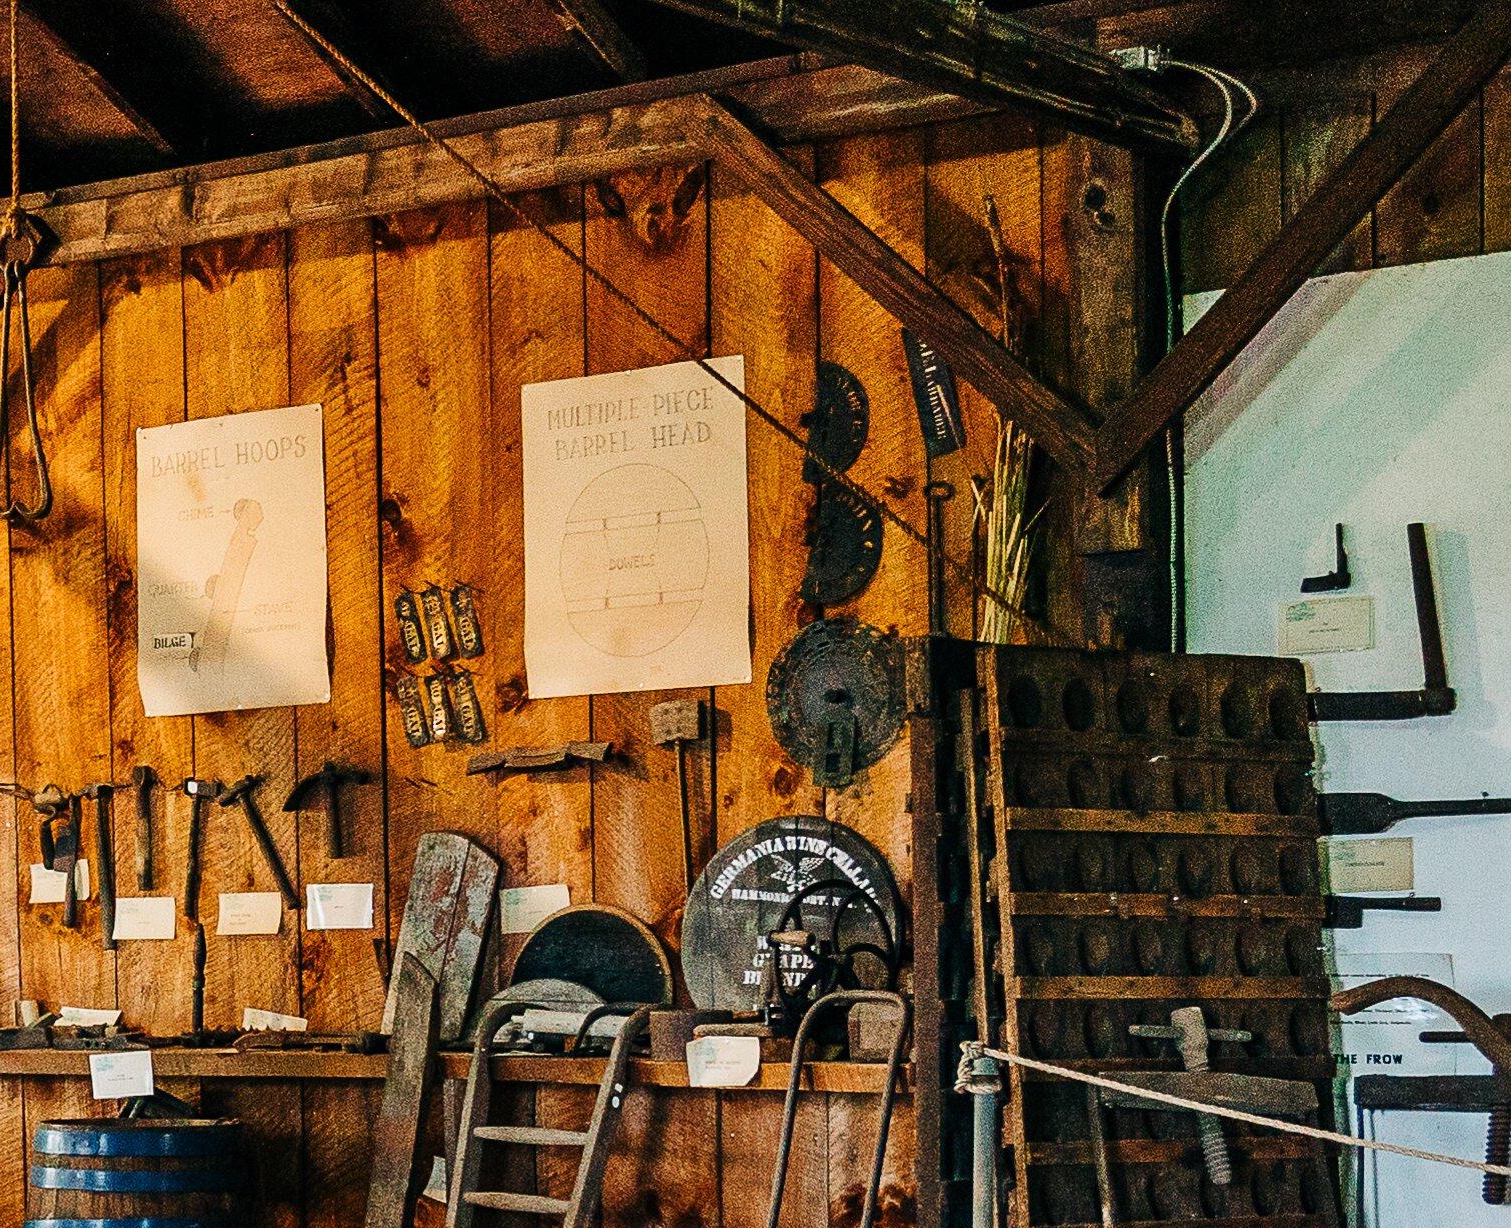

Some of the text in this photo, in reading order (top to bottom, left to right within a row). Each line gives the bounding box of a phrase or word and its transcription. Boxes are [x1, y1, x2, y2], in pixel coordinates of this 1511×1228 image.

[547, 386, 714, 431] MULTIPLE PIECE
[151, 435, 307, 478] BARREL HOOPS
[554, 421, 712, 461] BARREL HEAD
[154, 636, 187, 650] BILGE
[710, 837, 784, 900] GERMANIA
[783, 836, 828, 855] WINE
[1334, 1054, 1403, 1065] THE FROW
